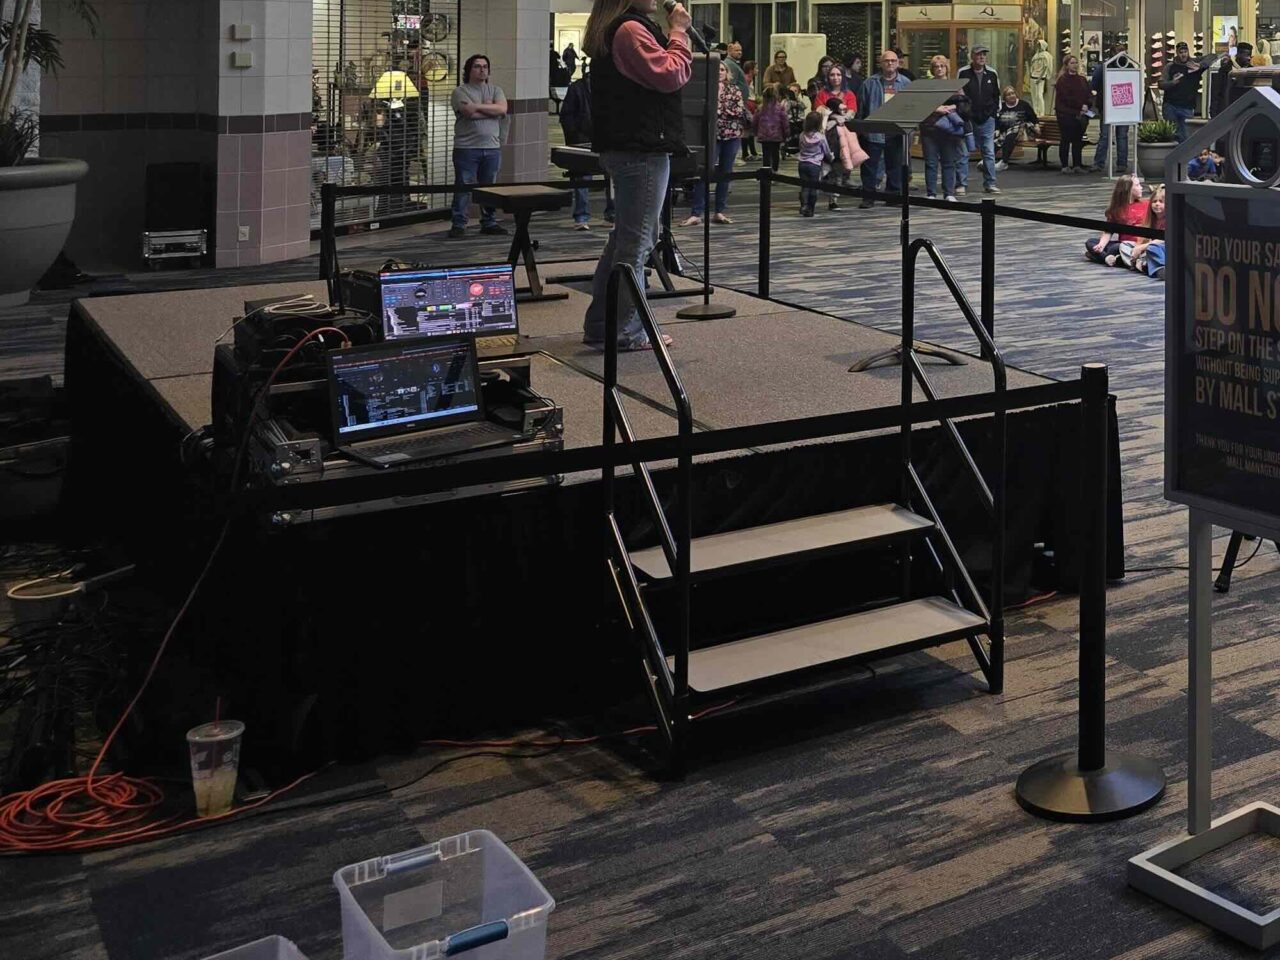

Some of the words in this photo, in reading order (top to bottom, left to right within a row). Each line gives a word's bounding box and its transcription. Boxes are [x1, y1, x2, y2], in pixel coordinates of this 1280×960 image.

[1195, 234, 1221, 262] FOR
[1224, 237, 1260, 265] YOUR
[1195, 262, 1238, 326] DO
[1195, 326, 1225, 352] STEP
[1228, 331, 1245, 356] ON
[1249, 334, 1273, 360] THE
[1195, 354, 1233, 376] WITHOUT
[1234, 361, 1261, 382] BEING
[1195, 376, 1216, 406] BY
[1219, 380, 1263, 417] MALL
